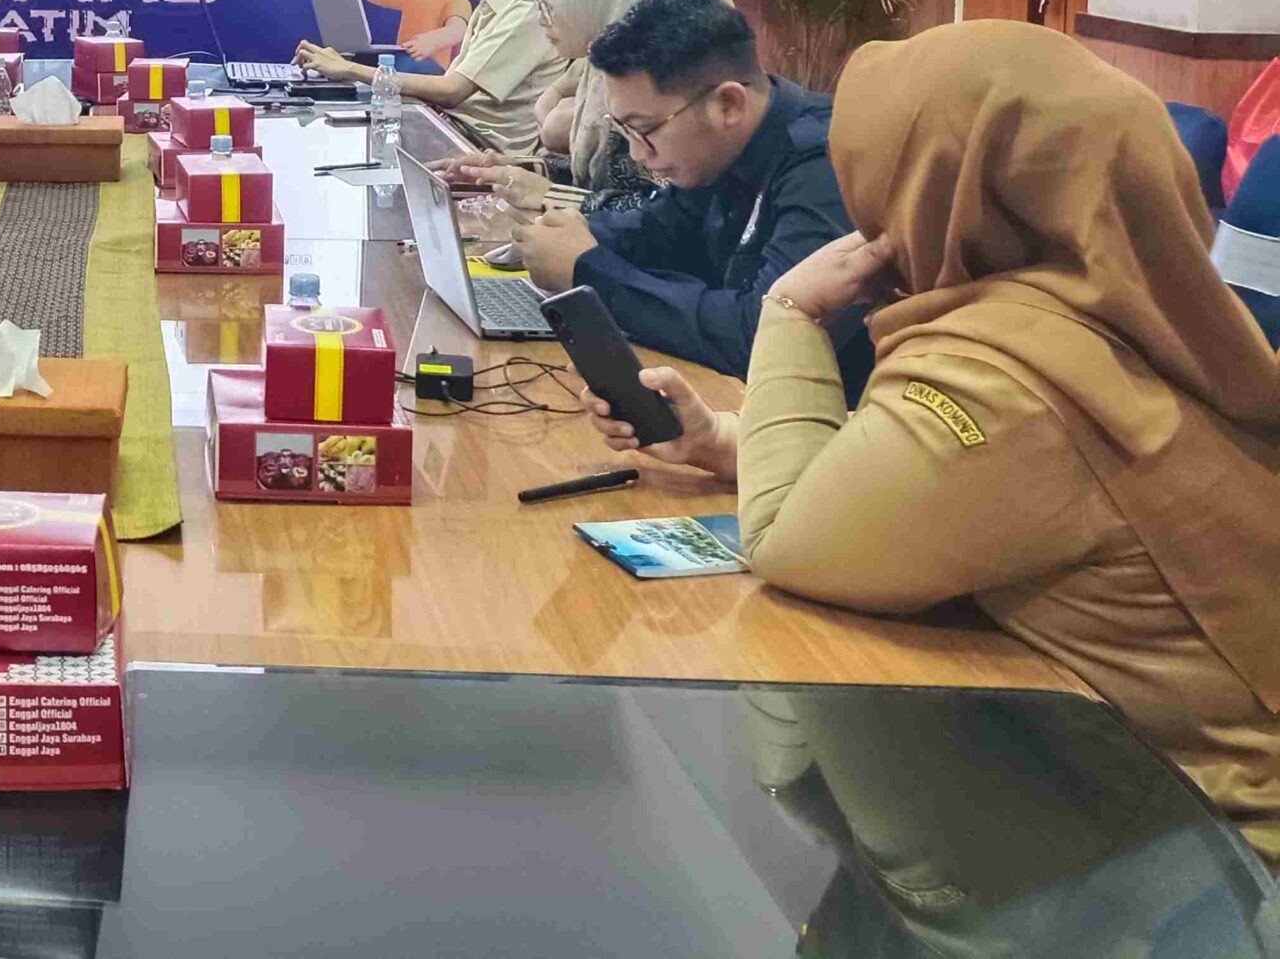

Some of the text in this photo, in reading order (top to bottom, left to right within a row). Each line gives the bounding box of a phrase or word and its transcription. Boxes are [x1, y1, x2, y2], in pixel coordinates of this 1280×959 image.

[908, 383, 980, 443] DINAS KOMINFO
[20, 585, 51, 595] Catering
[53, 586, 80, 594] Official
[20, 614, 37, 622] Jaya
[39, 614, 72, 623] Surabaya
[20, 623, 38, 632] Jaya
[9, 696, 111, 708] Enggal Catering Official
[9, 708, 72, 720] Enggal Official
[9, 733, 102, 744] Enggal Jaya Surabaya
[9, 746, 60, 757] Enggal Jaya
